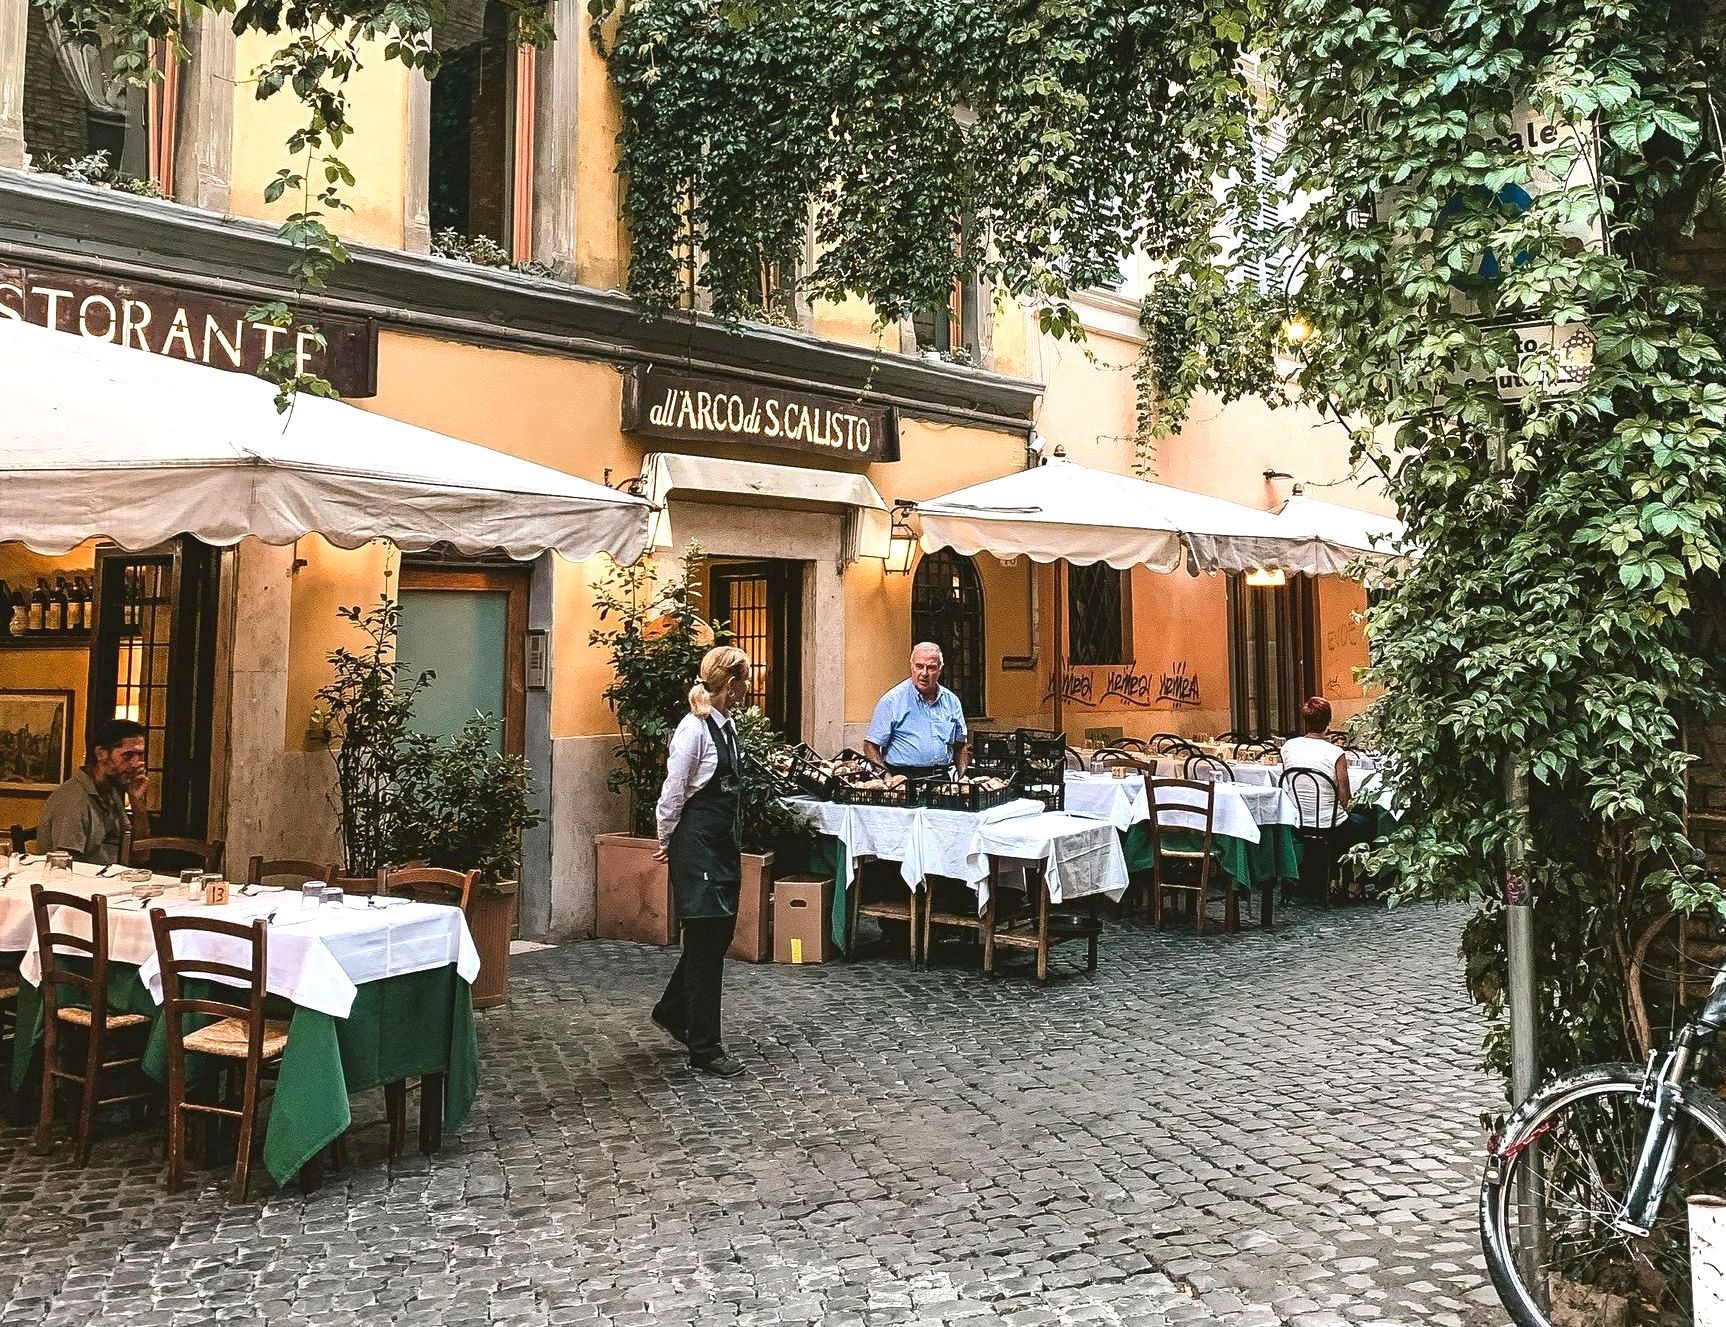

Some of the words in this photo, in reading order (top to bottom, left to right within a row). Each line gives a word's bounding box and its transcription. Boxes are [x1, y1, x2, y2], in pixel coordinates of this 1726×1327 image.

[743, 397, 762, 434] di
[765, 399, 872, 453] S.CALISTO
[212, 886, 225, 903] 13
